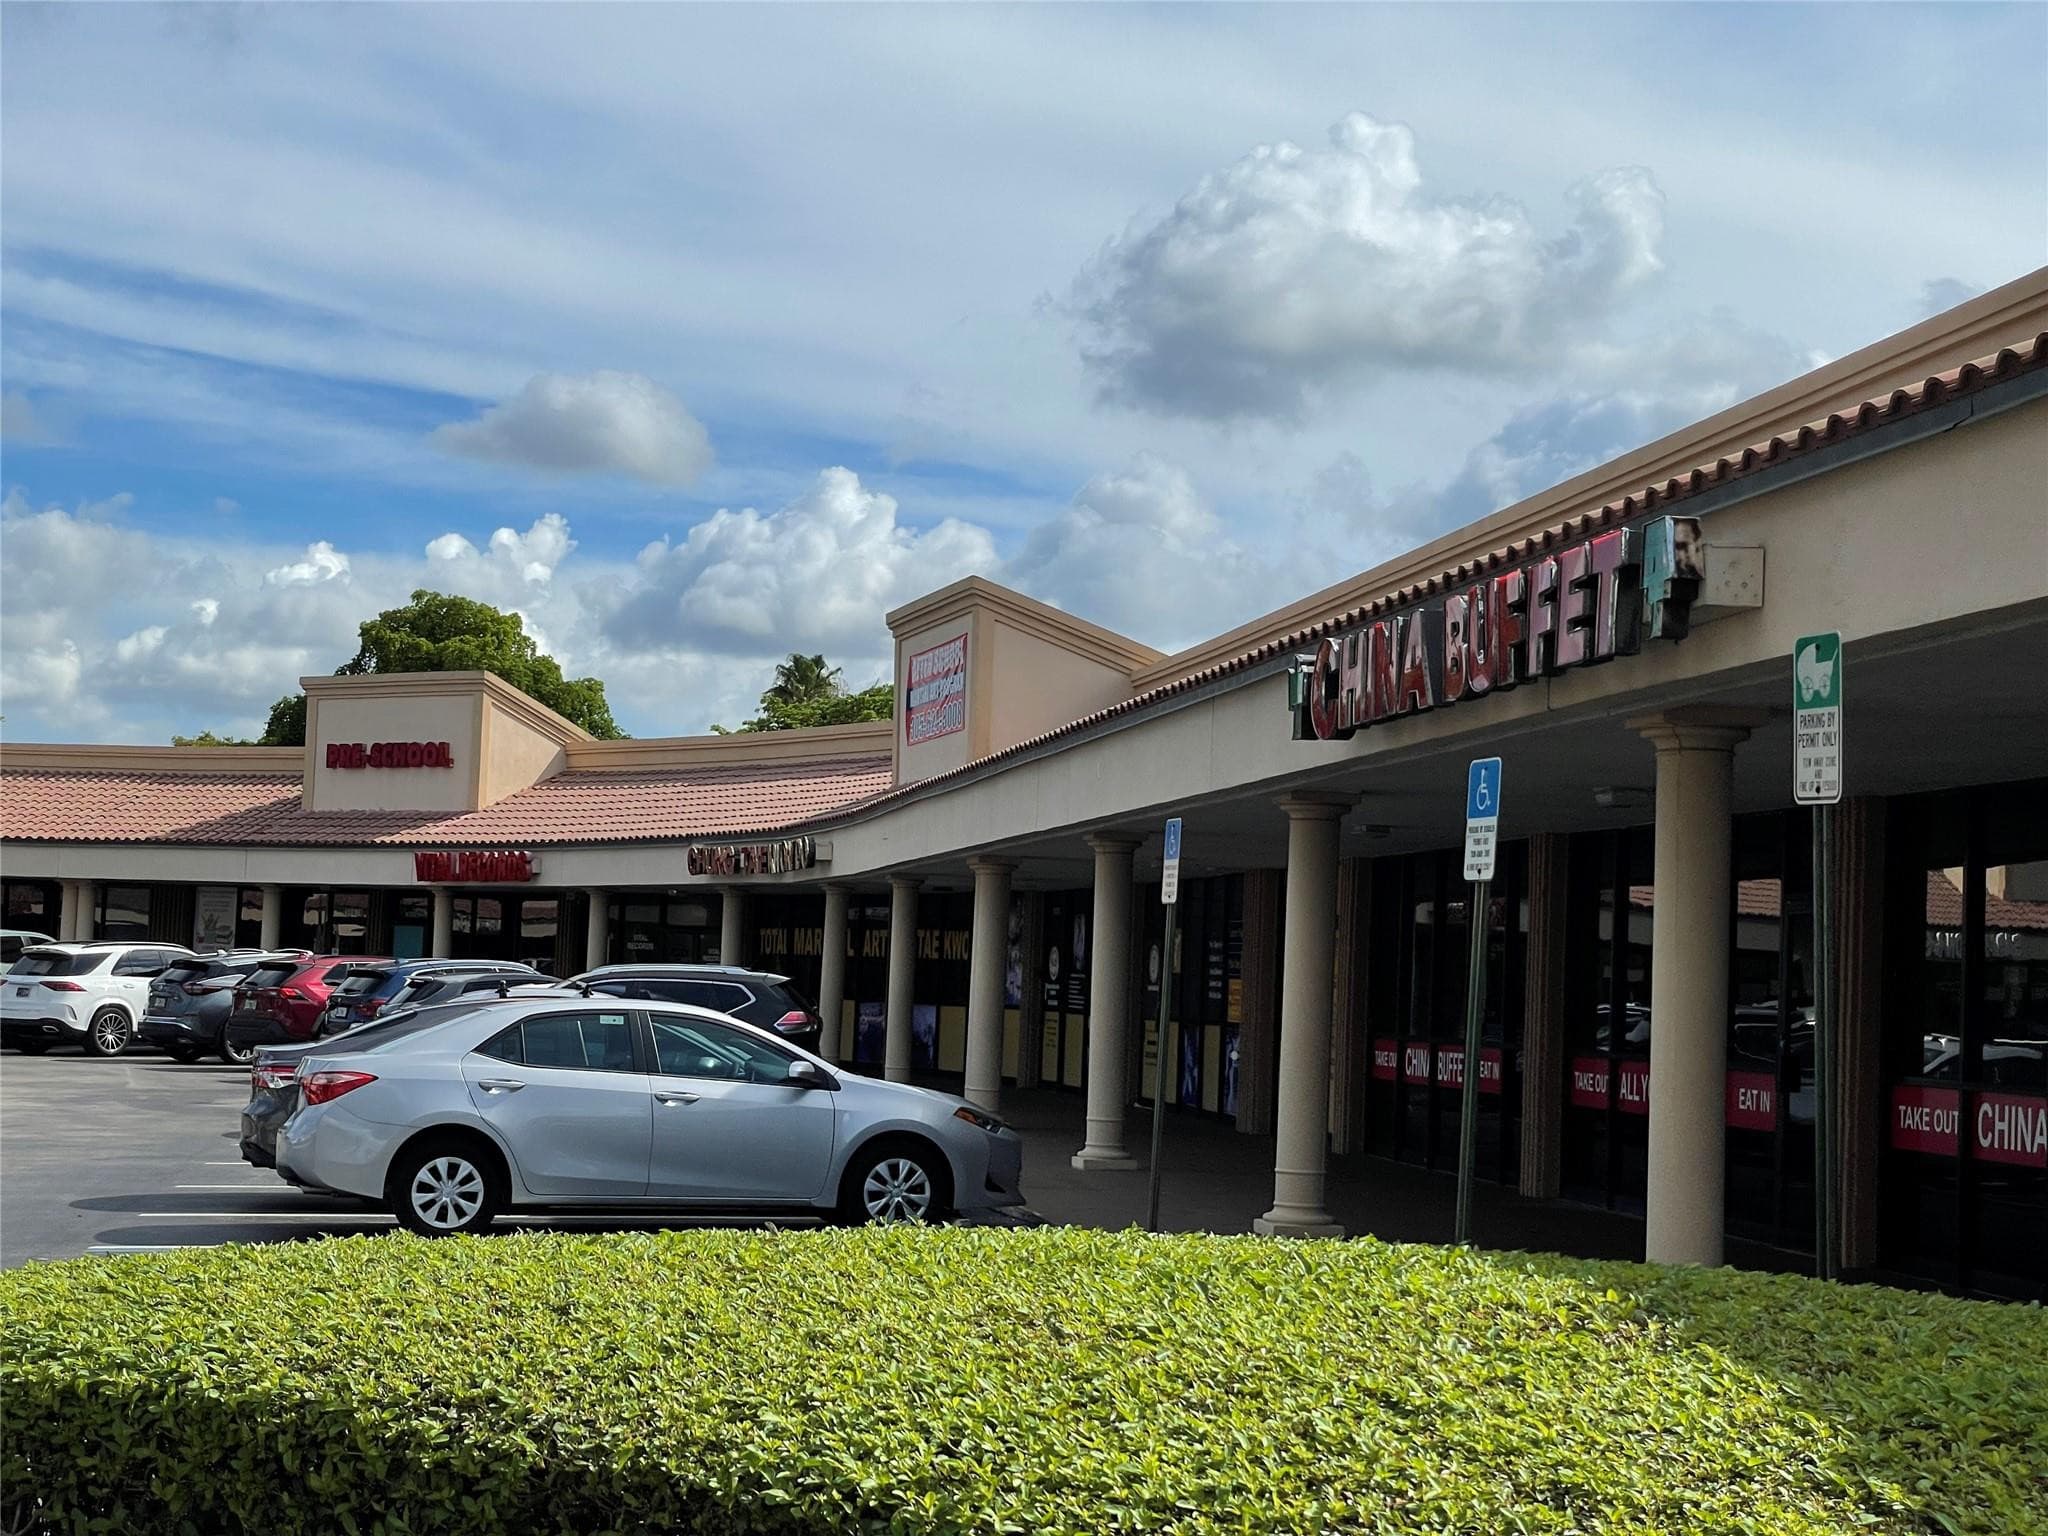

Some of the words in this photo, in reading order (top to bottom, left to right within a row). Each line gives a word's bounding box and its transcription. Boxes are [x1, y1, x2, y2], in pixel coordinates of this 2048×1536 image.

[1311, 609, 1436, 740] CHINA
[1443, 527, 1637, 701] BUFFET
[1799, 713, 1825, 729] PARKING
[1827, 712, 1836, 727] BY
[1798, 732, 1820, 748] PERMIT
[1822, 731, 1837, 747] ONLY
[326, 741, 454, 769] PRE-SCHOOL
[459, 851, 533, 882] RECORDS
[760, 928, 788, 955] TOTAL
[863, 929, 888, 957] ART
[917, 929, 939, 960] TAE
[944, 930, 969, 960] KWO
[1375, 1051, 1388, 1066] TAKE
[1389, 1052, 1397, 1068] OU
[1438, 1052, 1465, 1082] BUFFE
[1480, 1061, 1492, 1079] EAT
[1493, 1062, 1500, 1080] IN
[1574, 1071, 1594, 1092] TAKE
[1619, 1072, 1640, 1102] ALL
[1738, 1088, 1758, 1111] EAT
[1760, 1090, 1770, 1113] IN
[1899, 1105, 1930, 1131] TAKE
[1934, 1109, 1959, 1135] OUT
[1978, 1102, 2047, 1153] CHINA
